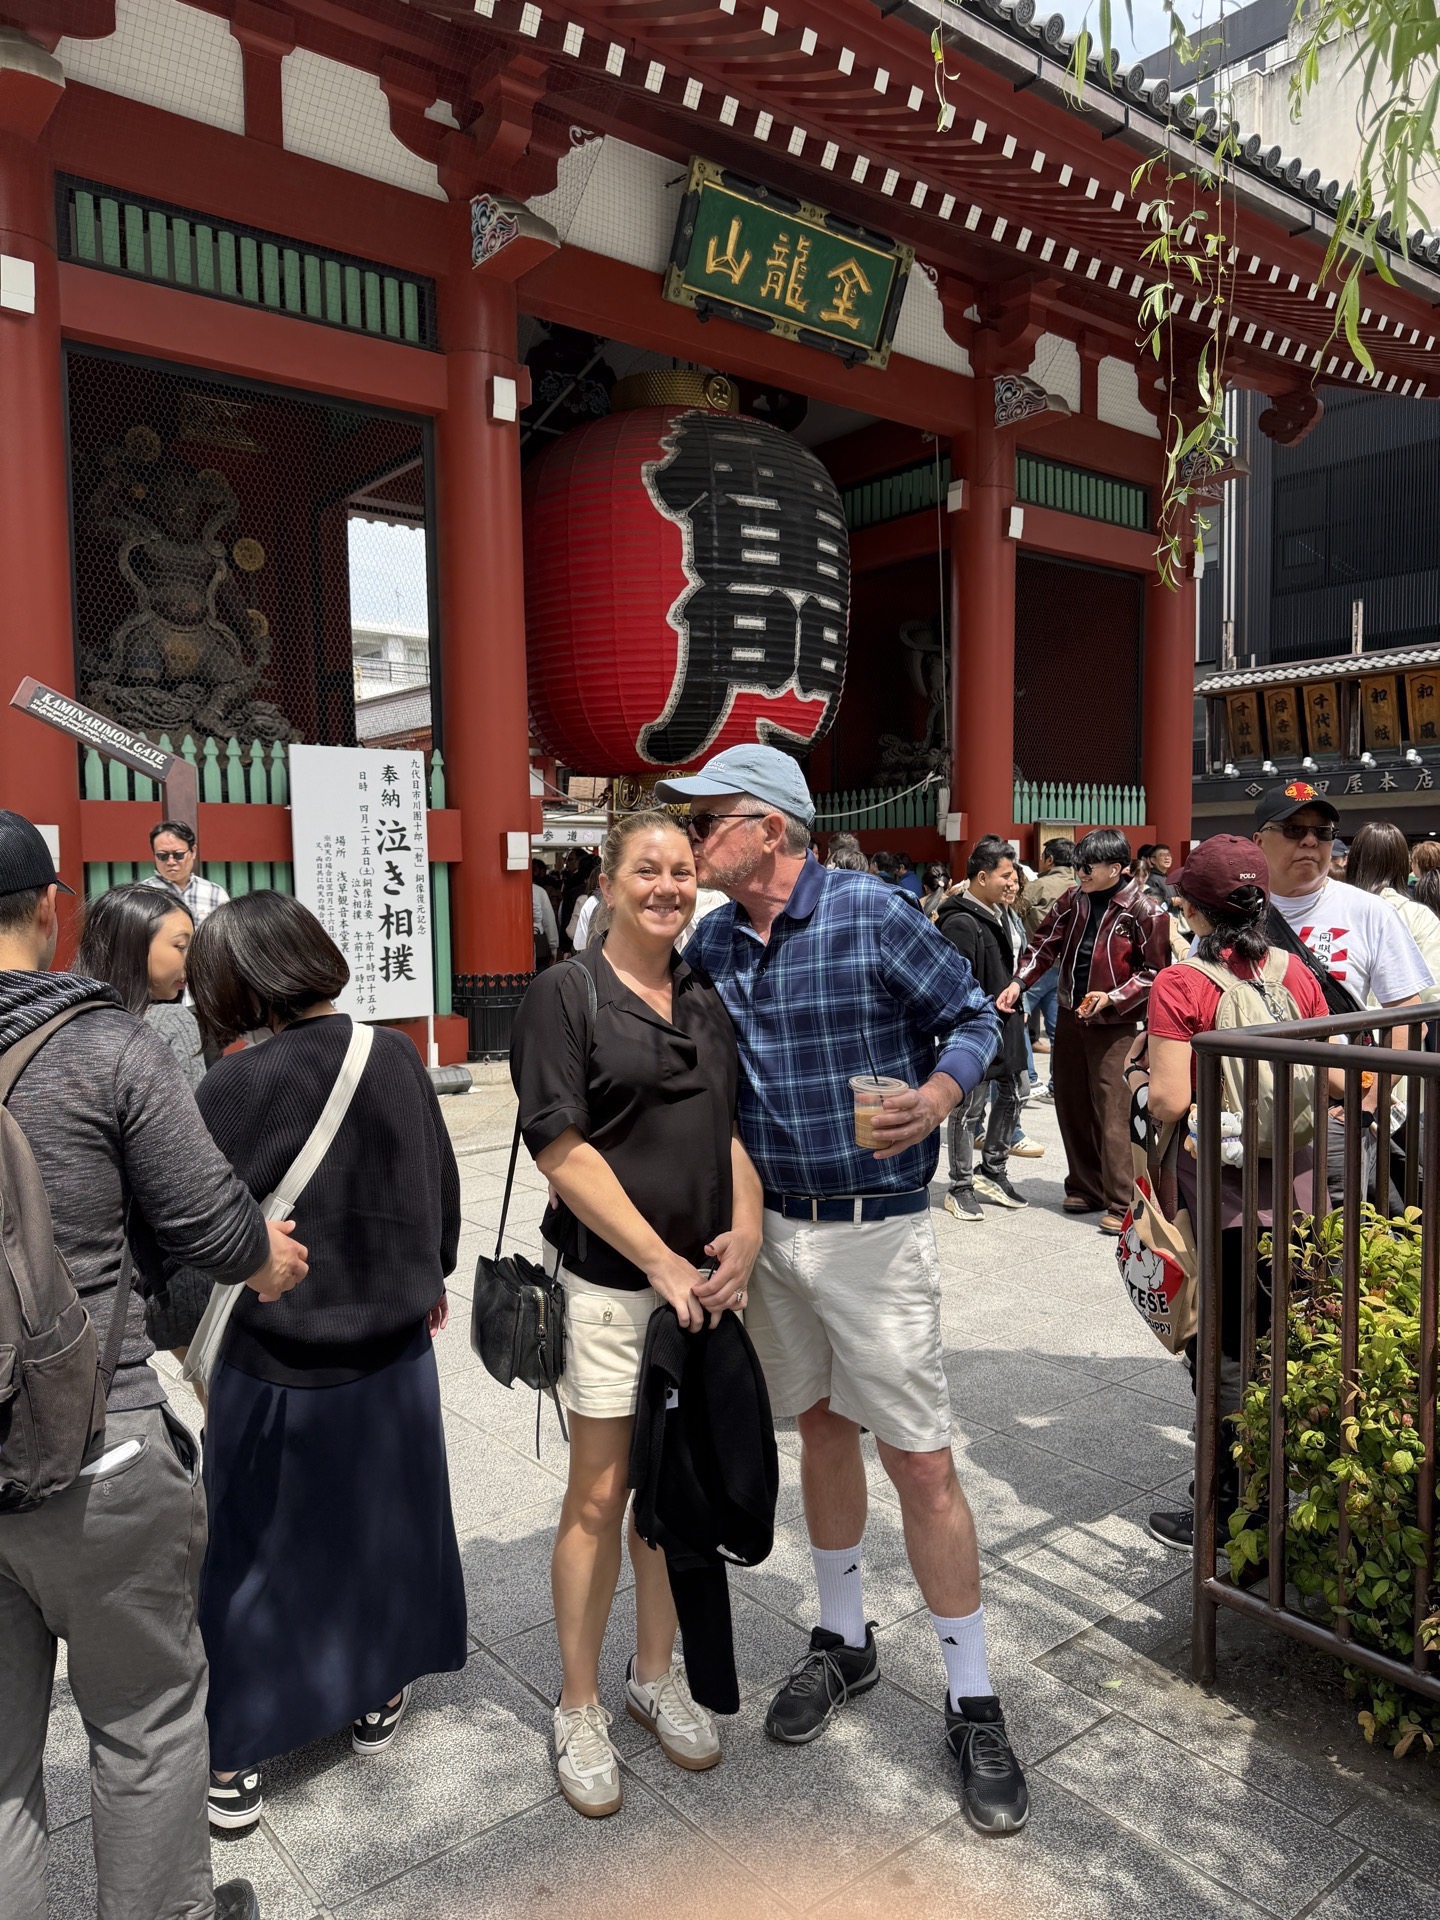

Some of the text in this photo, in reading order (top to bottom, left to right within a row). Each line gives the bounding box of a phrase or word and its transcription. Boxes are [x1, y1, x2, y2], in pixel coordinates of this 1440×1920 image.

[41, 692, 167, 765] KAMINARIMON GATE
[1371, 688, 1390, 741] 和紙
[358, 771, 368, 792] 日時
[1286, 768, 1434, 794] 田屋本店
[335, 835, 346, 858] 場所
[375, 764, 416, 983] 奉納 泣き相撲
[1239, 872, 1256, 880] POLO
[351, 878, 365, 1005] 泣き相撲 午前十一時十分
[365, 931, 377, 1014] 午前十時四十五分
